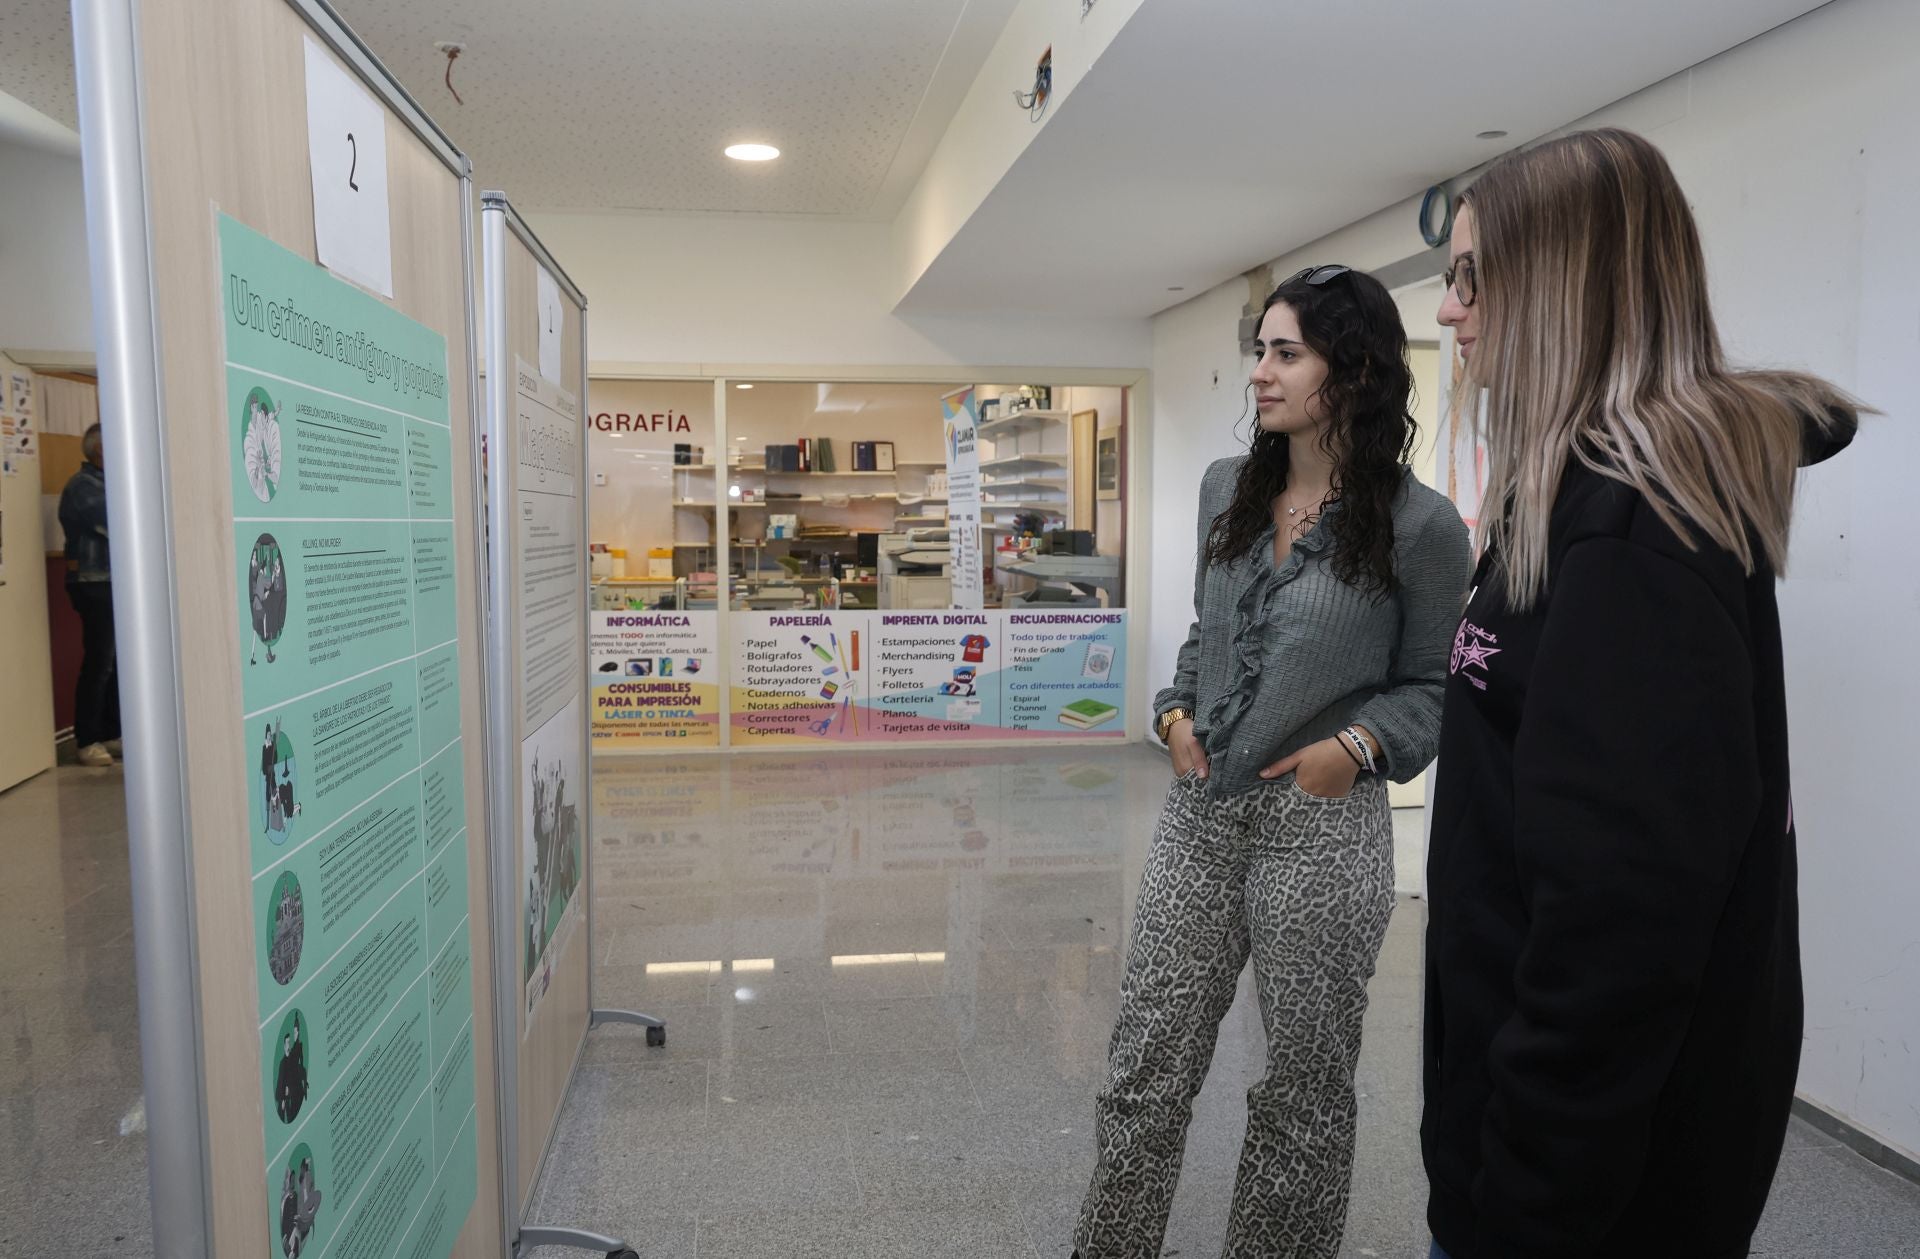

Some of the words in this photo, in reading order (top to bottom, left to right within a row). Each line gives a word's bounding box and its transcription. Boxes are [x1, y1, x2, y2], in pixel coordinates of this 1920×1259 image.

[347, 132, 359, 192] 2
[231, 274, 264, 332] Un
[267, 298, 334, 358] crimen
[336, 331, 391, 383] antiguo
[392, 354, 400, 392] y
[402, 359, 444, 399] popular
[588, 410, 691, 433] GRAFÍA
[607, 614, 690, 627] INFORMÁTICA
[770, 614, 832, 626] PAPELERÍA
[882, 615, 938, 626] IMPRENTA
[943, 614, 988, 625] DIGITAL
[1010, 614, 1122, 624] ENCUADERNACIONES
[882, 637, 956, 648] Estampaciones
[1036, 634, 1054, 642] tipo
[1070, 633, 1108, 642] trabajos:
[746, 638, 777, 649] Papel
[747, 650, 802, 662] Bolígrafos
[882, 652, 955, 662] Merchandising
[747, 664, 812, 673] Rotuladores
[882, 666, 914, 676] Flyers
[747, 676, 822, 687] Subrayadores
[882, 680, 924, 690] Folletos
[1030, 682, 1074, 690] diferentes
[608, 683, 690, 694] CONSUMIBLES
[747, 688, 806, 698] Cuadernos
[598, 697, 632, 708] PARA
[637, 694, 701, 706] IMPRESIÓN
[882, 694, 934, 704] Cartelería
[748, 702, 779, 710] Notas
[781, 700, 836, 710] adhesivas
[604, 708, 642, 720] LÁSER
[645, 710, 654, 719] O
[658, 710, 695, 718] TINTA
[748, 714, 810, 723] Correctores
[882, 709, 918, 718] Planos
[748, 726, 796, 736] Capertas
[882, 722, 924, 734] Tarjetas
[926, 722, 940, 732] de
[943, 722, 970, 732] visita
